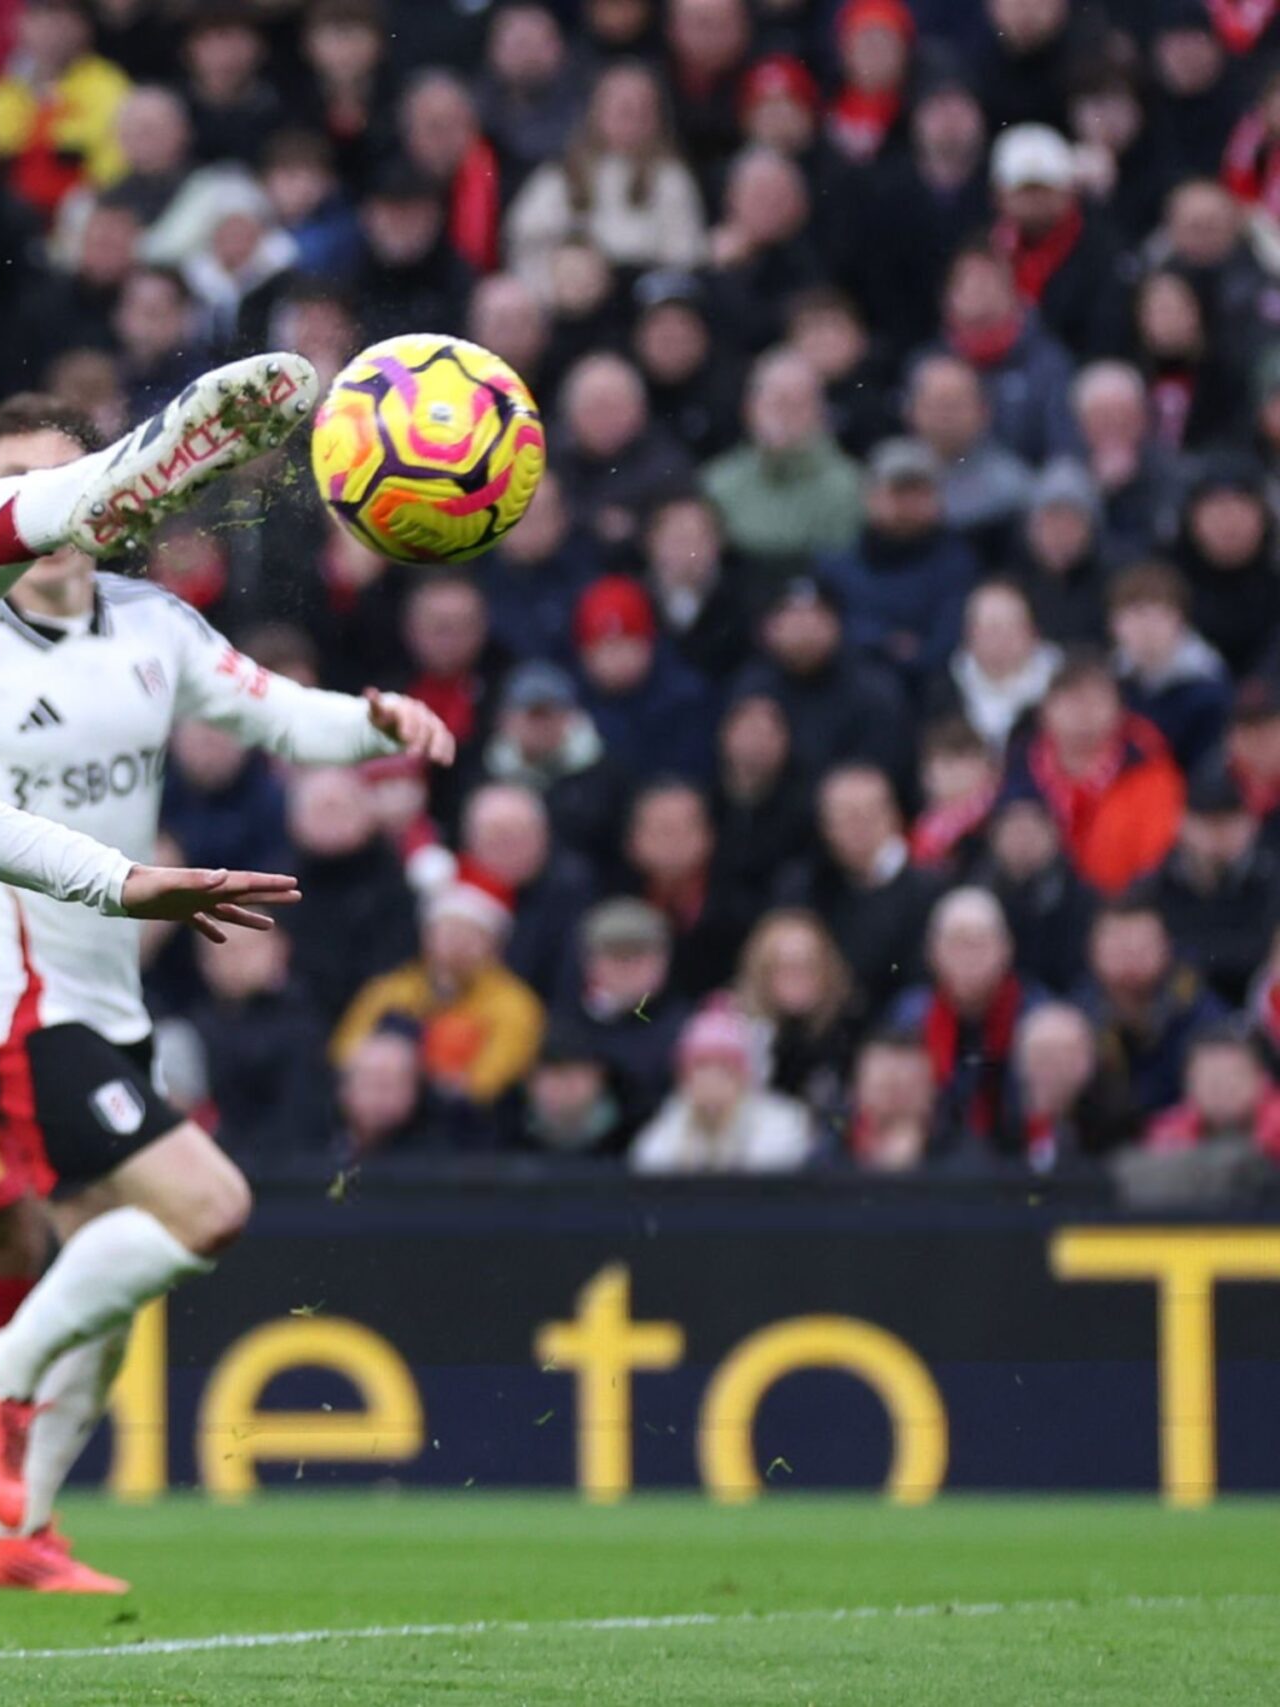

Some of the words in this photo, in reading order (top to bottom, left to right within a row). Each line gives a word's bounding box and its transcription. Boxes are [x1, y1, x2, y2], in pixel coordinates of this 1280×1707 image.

[83, 372, 298, 544] PEDATOR
[533, 1262, 949, 1505] to
[1048, 1225, 1280, 1509] T
